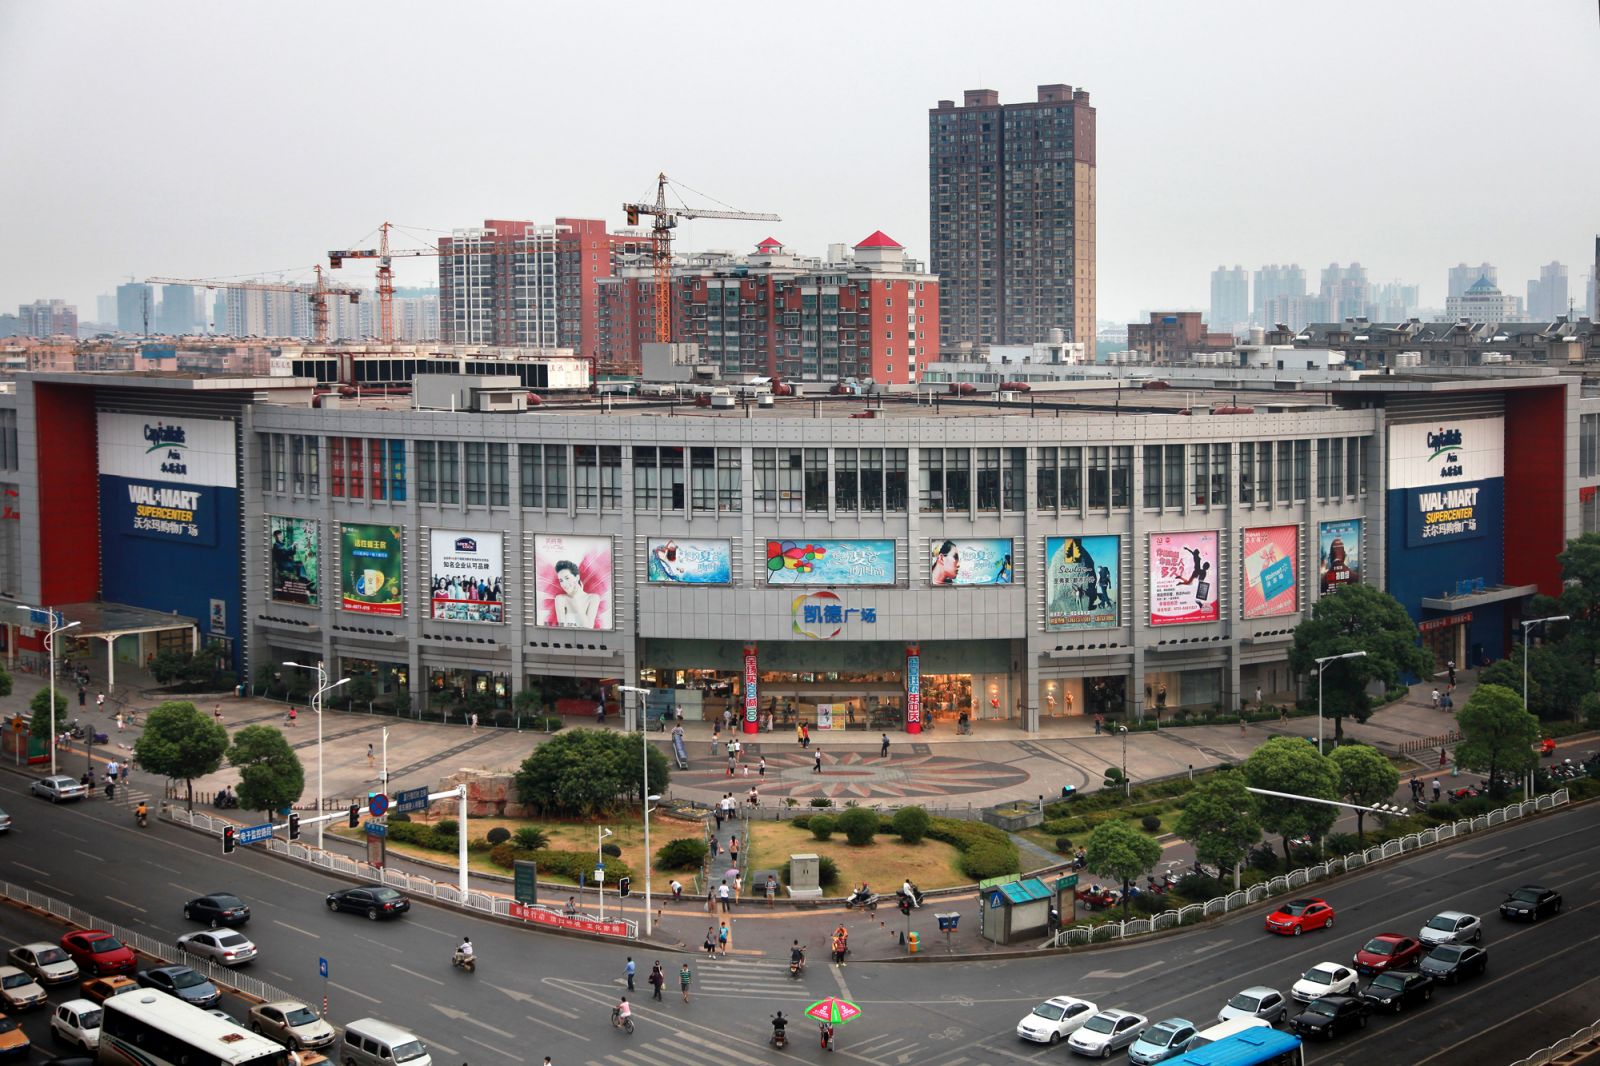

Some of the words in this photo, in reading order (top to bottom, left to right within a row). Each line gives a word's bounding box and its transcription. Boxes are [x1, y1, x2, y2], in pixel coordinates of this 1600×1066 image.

[136, 505, 193, 522] SUPERCENTER
[1426, 508, 1473, 524] SUPERCENTER
[134, 517, 198, 537] 沃尔玛购物广场
[1422, 519, 1477, 537] 沃尔玛购物广场
[803, 604, 877, 624] 凯德广场
